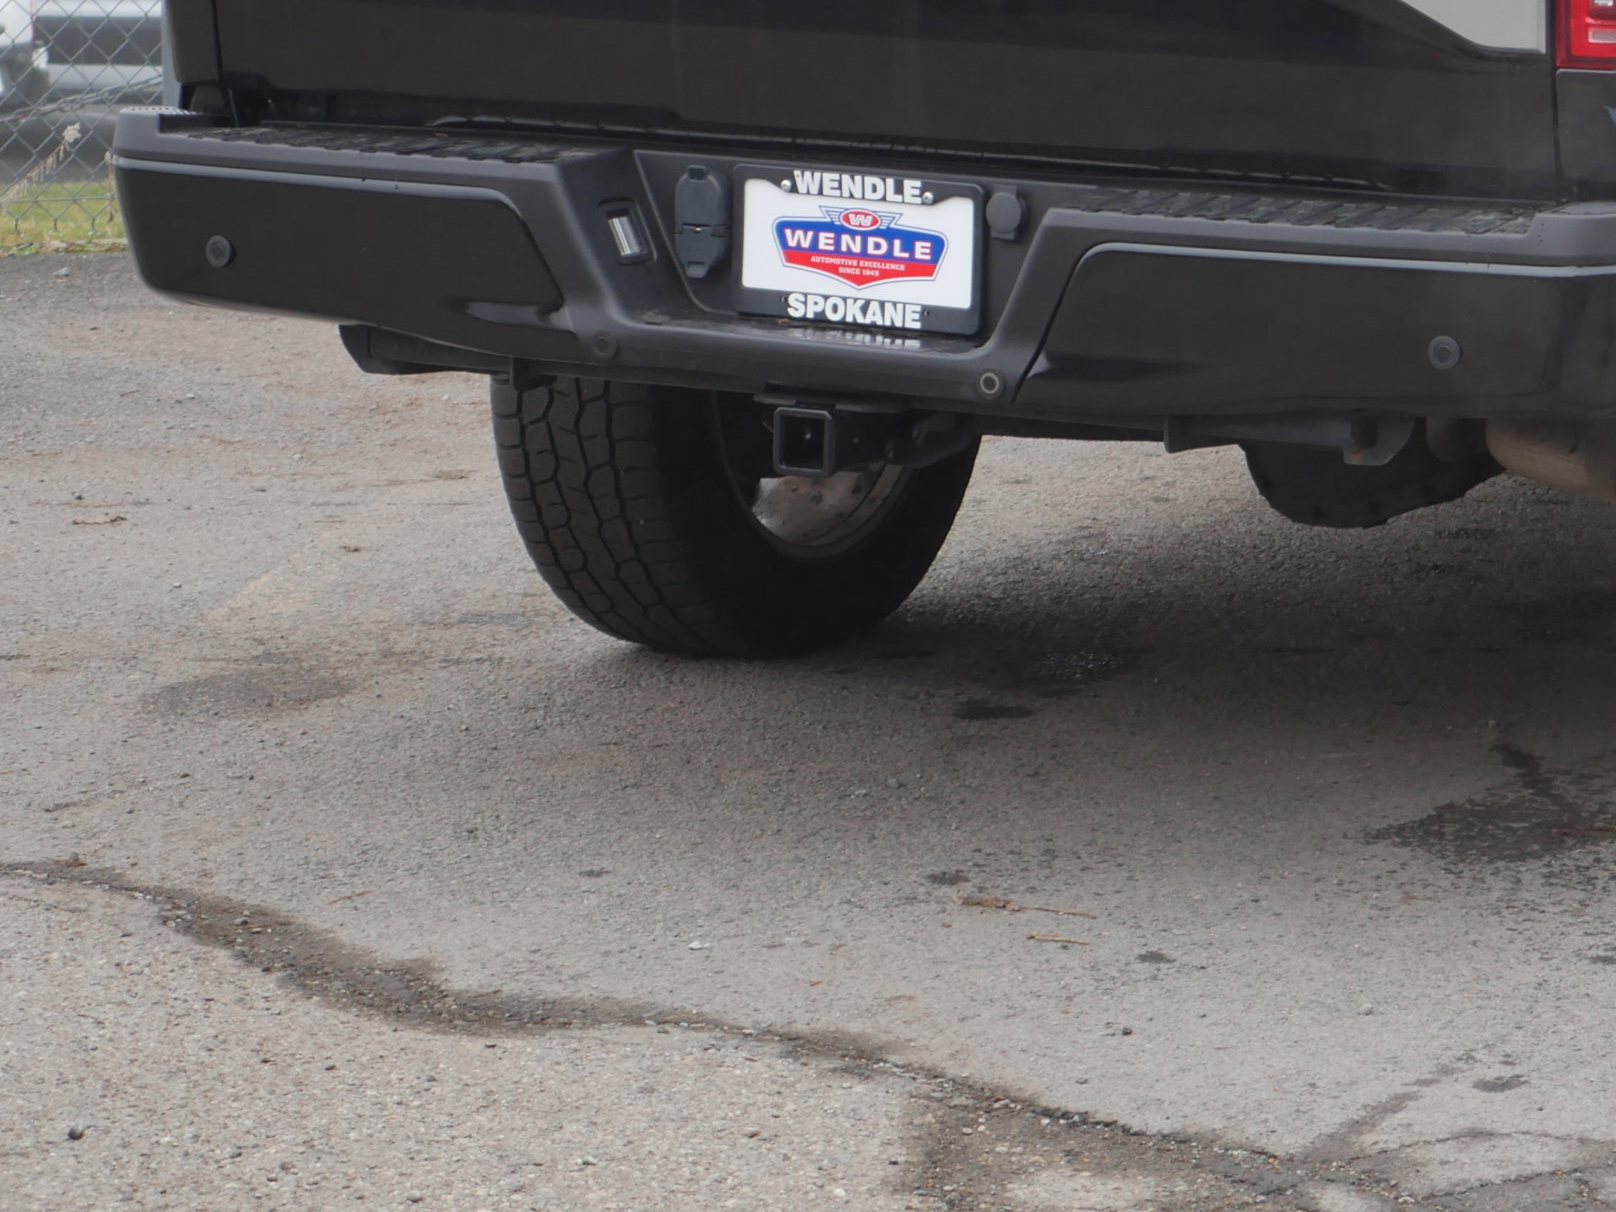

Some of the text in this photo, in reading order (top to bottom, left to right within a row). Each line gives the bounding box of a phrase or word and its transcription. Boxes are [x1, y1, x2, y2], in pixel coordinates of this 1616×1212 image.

[793, 169, 922, 205] WENDLE
[784, 228, 932, 260] WENDLE
[810, 256, 905, 271] AUTOMOTIVE EXCELLENCE
[838, 267, 861, 275] SINCE
[787, 292, 922, 329] SPOKANE
